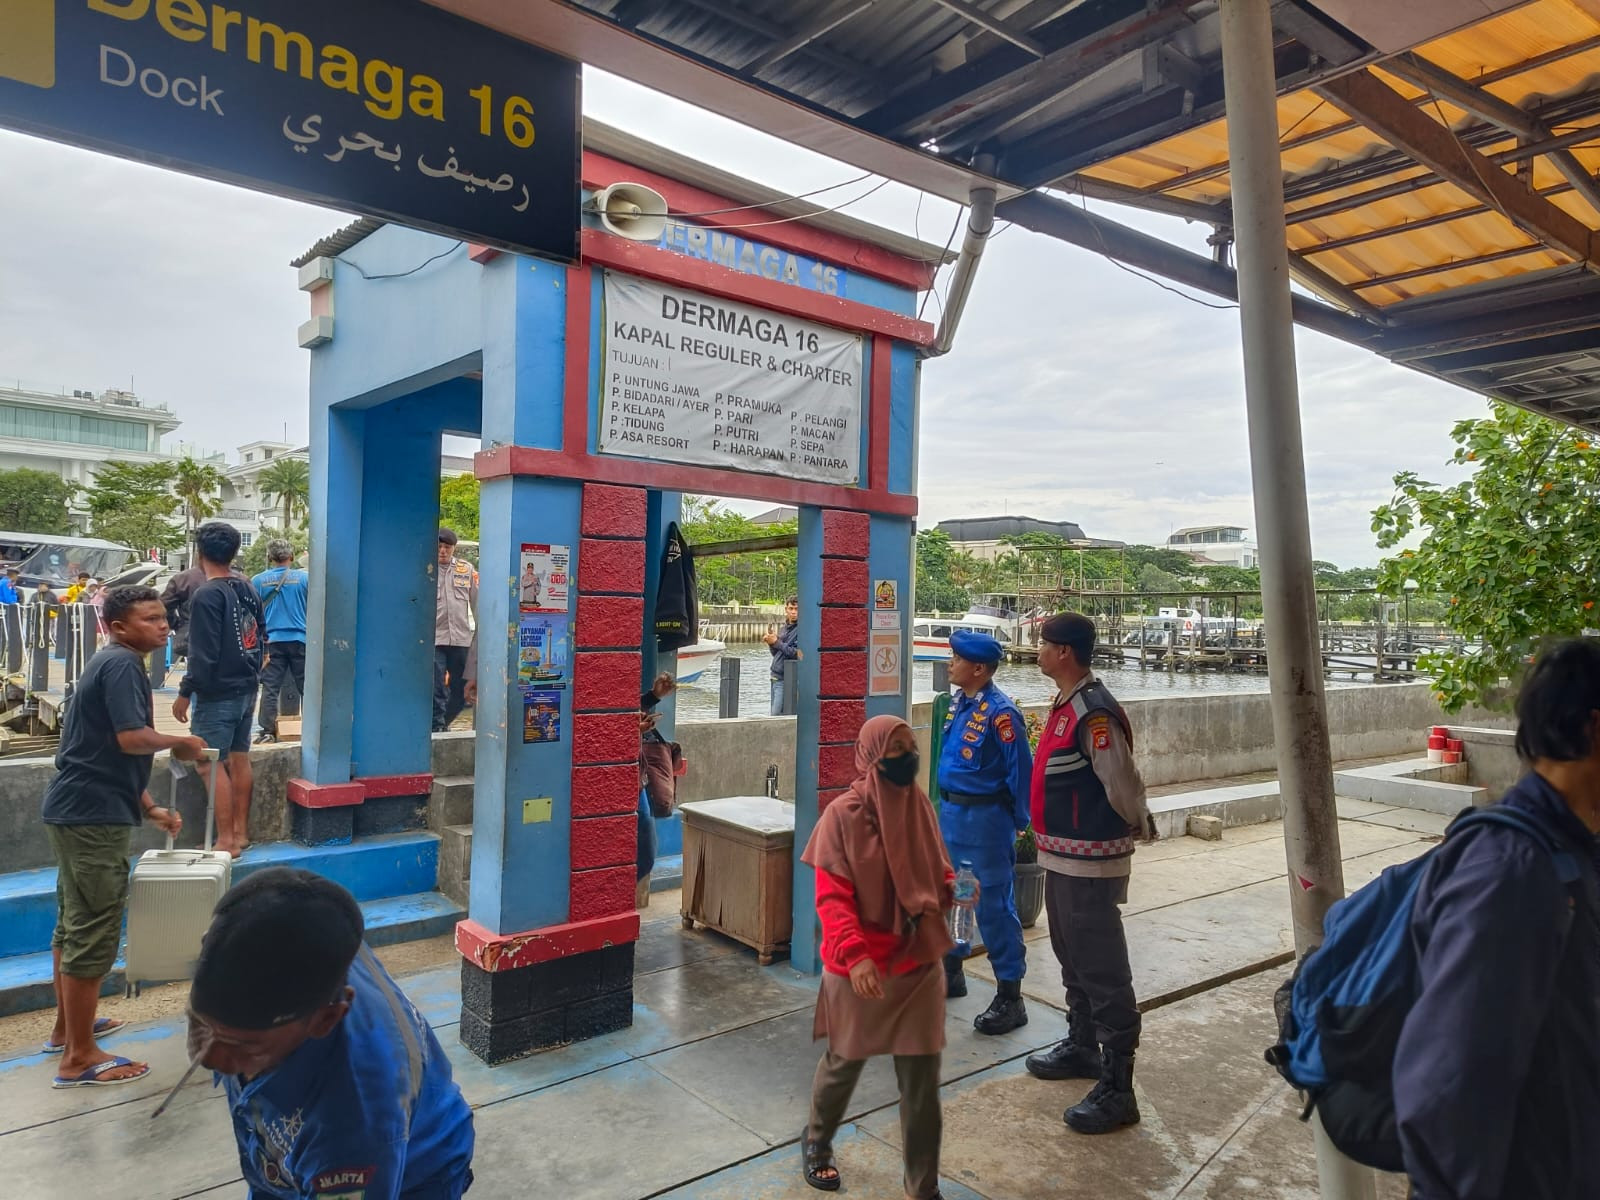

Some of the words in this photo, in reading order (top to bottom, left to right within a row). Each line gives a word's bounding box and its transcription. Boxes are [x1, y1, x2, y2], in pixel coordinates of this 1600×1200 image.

[88, 0, 445, 121] ermaga
[469, 84, 536, 148] 16
[99, 44, 225, 117] Dock
[282, 112, 402, 172] بحري
[417, 146, 530, 213] رصيف
[666, 224, 800, 286] ERMAGA
[811, 262, 839, 296] 16
[661, 294, 789, 348] DERMAGA
[795, 329, 819, 354] 16
[612, 349, 659, 369] TUJUAN
[614, 321, 675, 350] KAPAL
[680, 336, 762, 368] REGULER
[767, 355, 777, 372] &
[781, 359, 852, 386] CHARTER
[624, 375, 669, 392] UNTUNG
[672, 384, 700, 398] JAWA
[623, 403, 666, 419] KELAPA
[624, 389, 675, 407] BIDADARI
[682, 399, 710, 413] AYER
[727, 395, 782, 415] PRAMUKA
[727, 411, 754, 425] PARI
[805, 413, 847, 429] PELANGI
[621, 431, 644, 443] ASA
[646, 434, 690, 449] RESORT
[726, 426, 759, 441] PUTRI
[801, 427, 836, 441] MACAN
[730, 442, 784, 461] HARAPAN
[800, 440, 825, 453] SEPA
[804, 455, 848, 469] PANTARA
